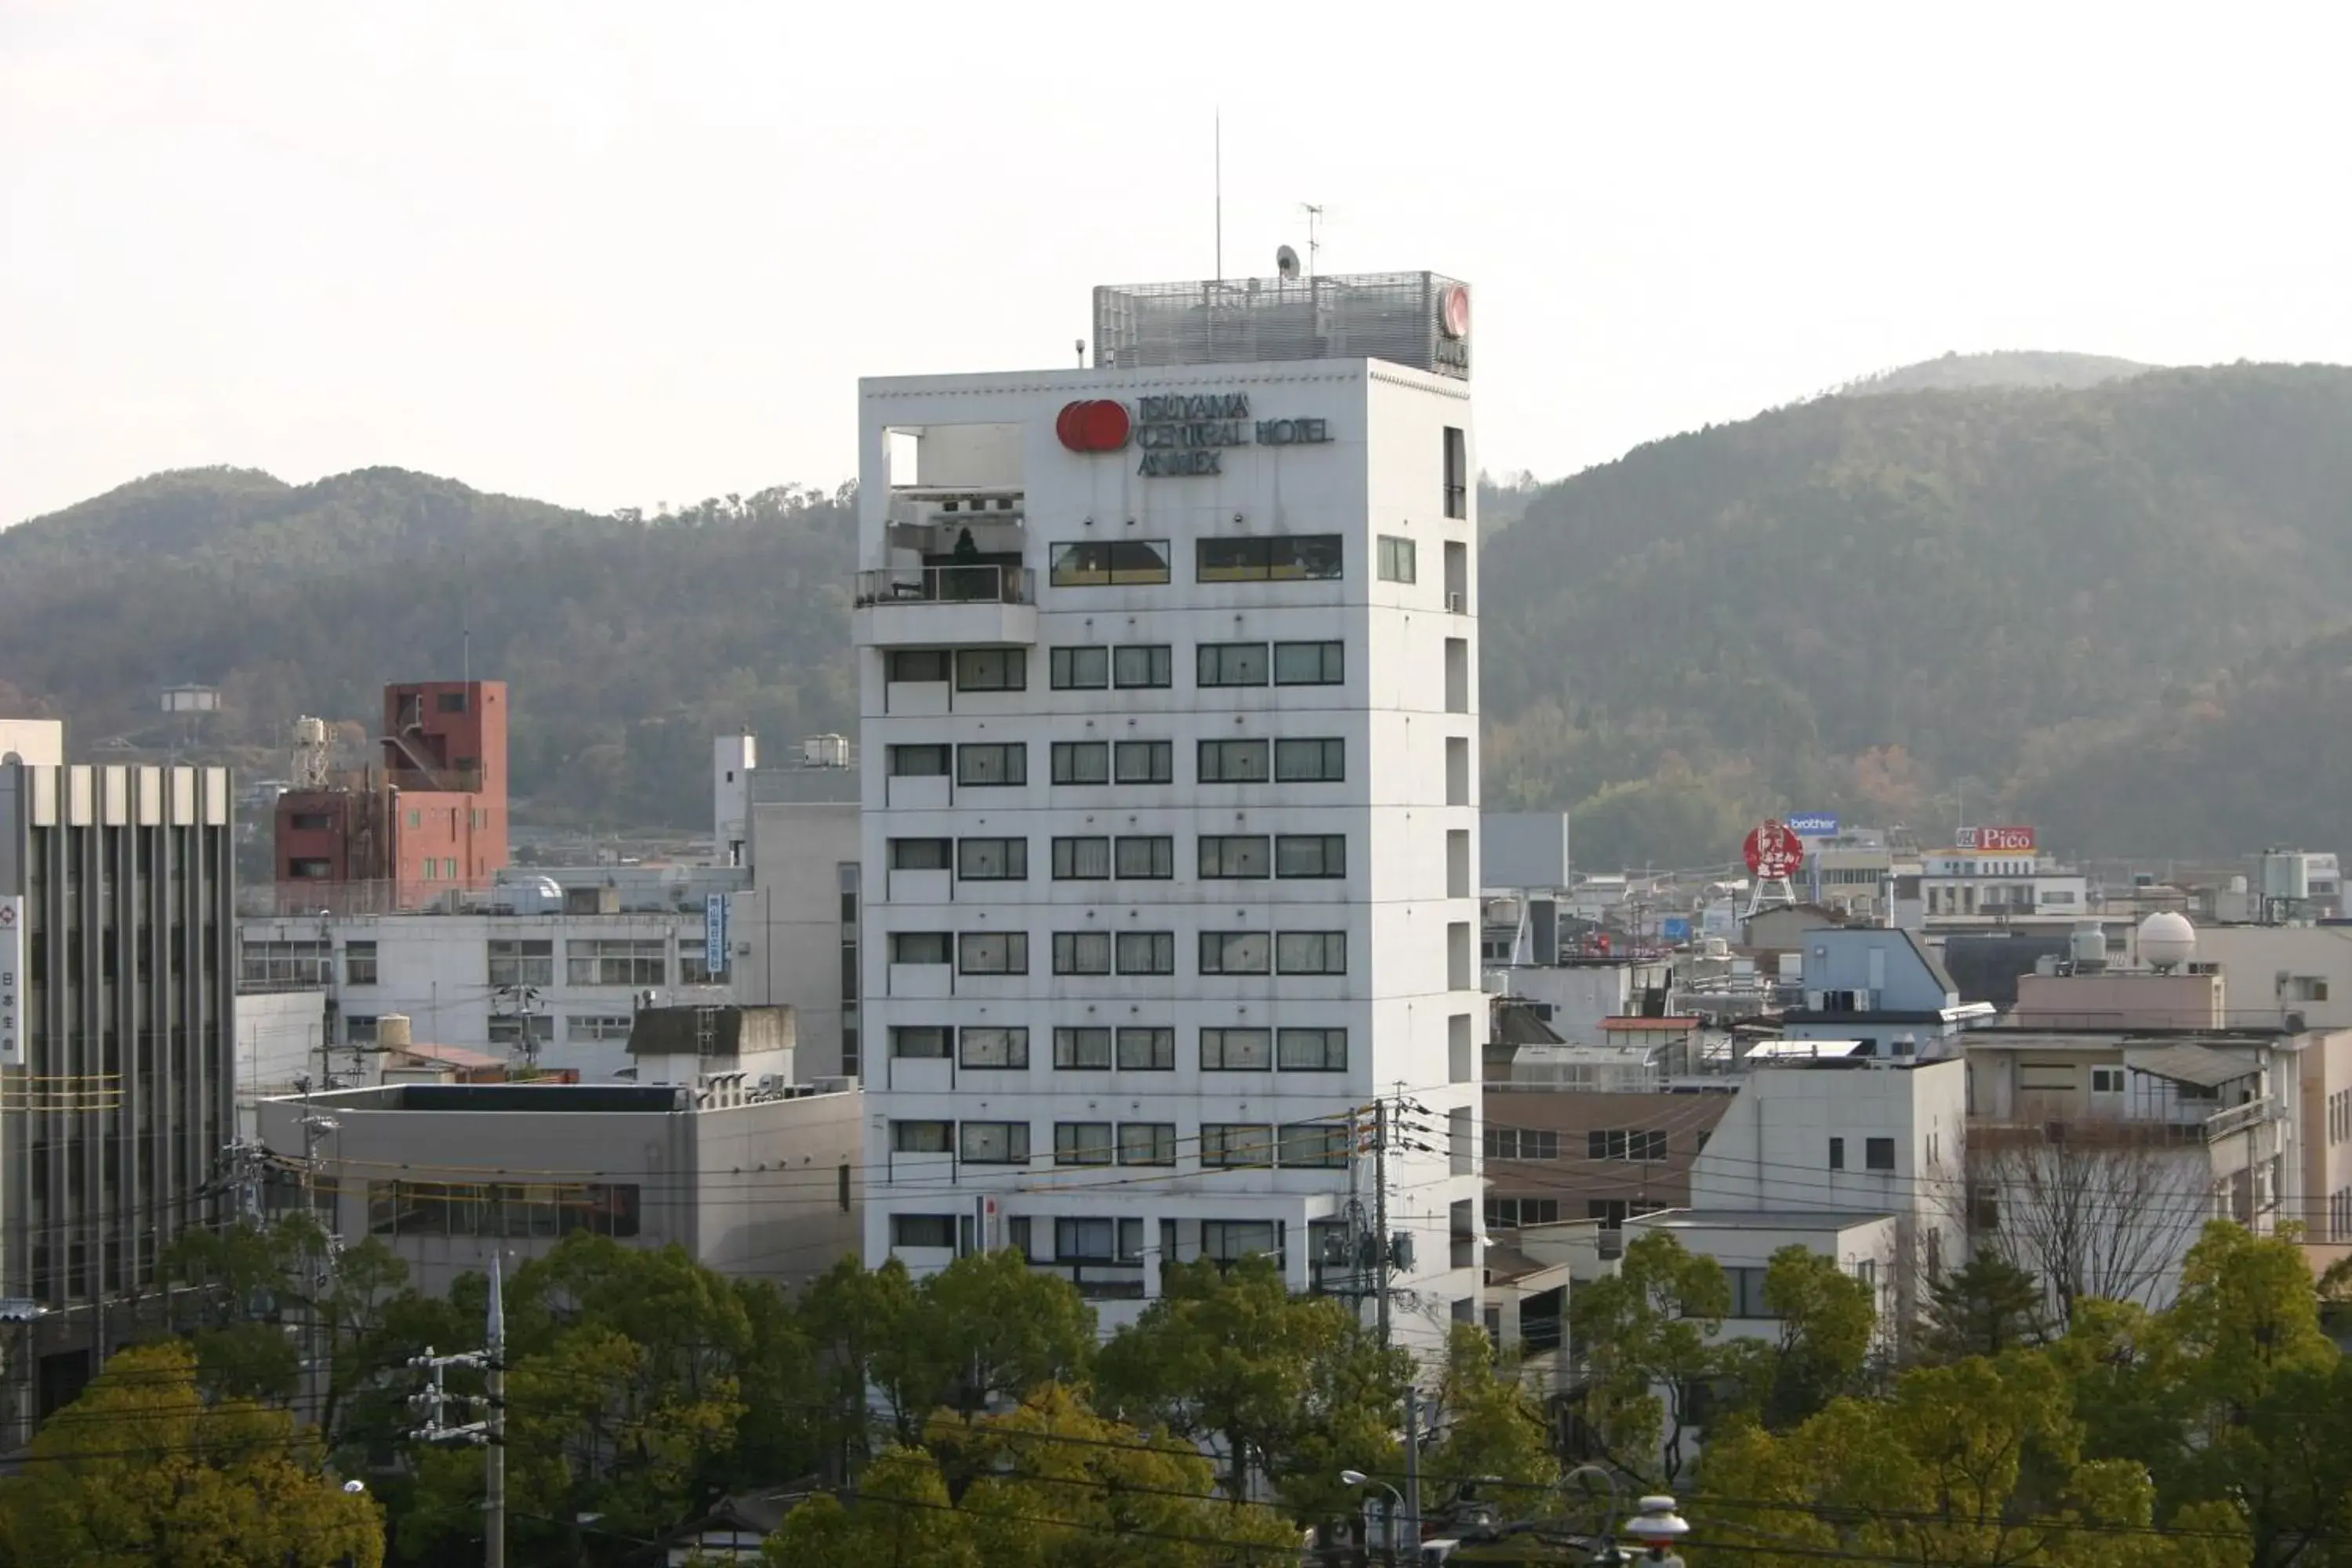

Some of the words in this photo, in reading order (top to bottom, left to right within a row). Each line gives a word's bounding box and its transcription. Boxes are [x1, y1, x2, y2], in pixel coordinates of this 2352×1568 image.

[1137, 392, 1250, 420] TSUYAMA
[1137, 421, 1251, 449] CENTRAL
[1256, 418, 1334, 446] HOTEL
[1137, 450, 1221, 477] ANNEX
[1791, 818, 1835, 829] brother
[1983, 829, 2030, 848] Pico
